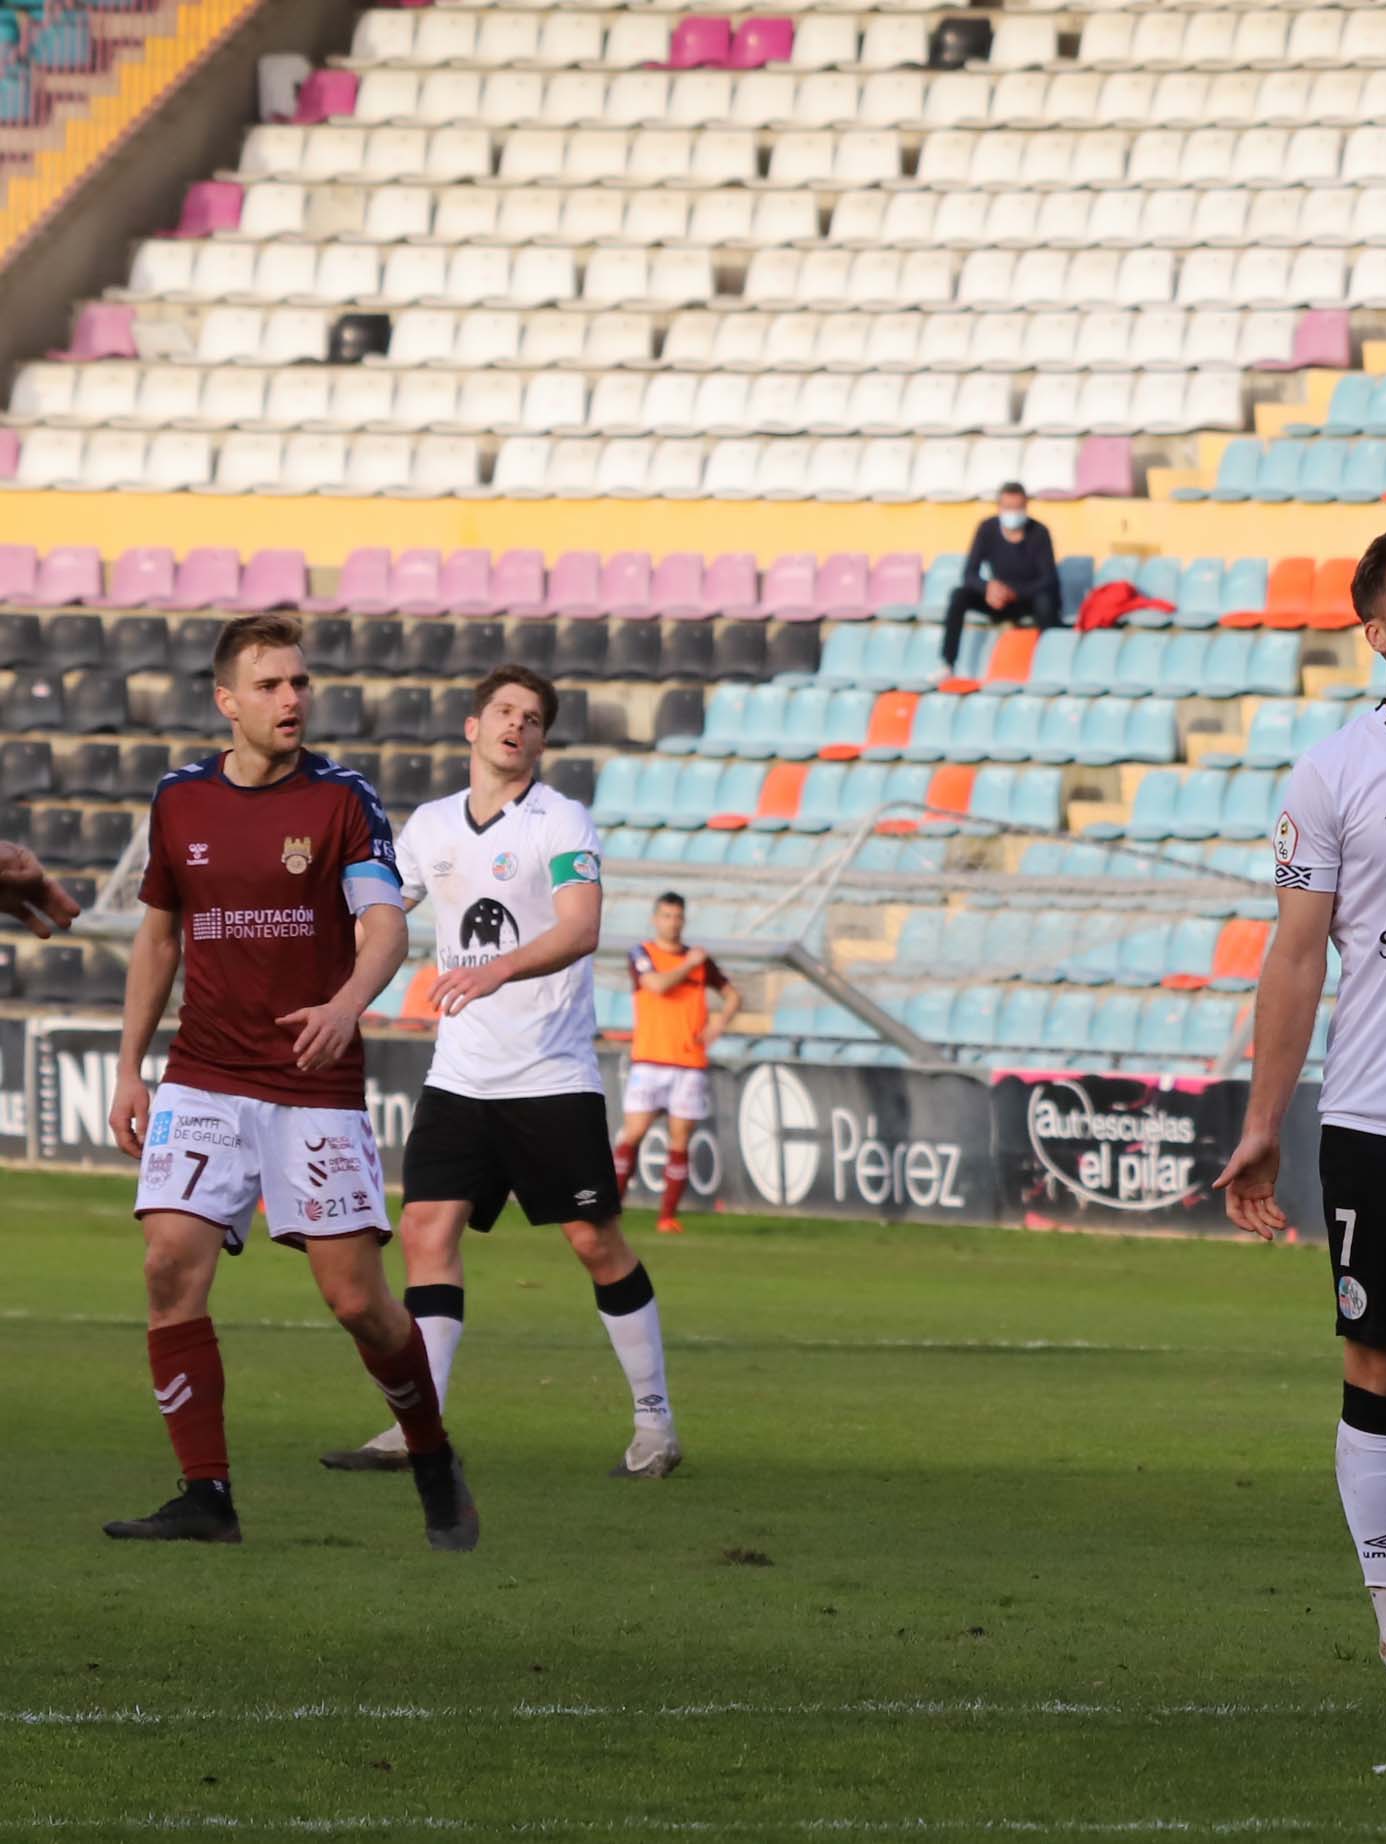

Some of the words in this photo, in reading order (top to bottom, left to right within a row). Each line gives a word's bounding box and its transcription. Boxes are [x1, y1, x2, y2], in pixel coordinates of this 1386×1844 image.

[224, 906, 315, 925] DEPUTACIÓN
[225, 923, 316, 940] PONTEVEDRA
[173, 1128, 190, 1140] DE
[831, 1107, 965, 1208] Pérez
[180, 1150, 209, 1201] 7
[1078, 1141, 1112, 1190] el
[1118, 1138, 1196, 1202] pilar
[1335, 1207, 1358, 1268] 7
